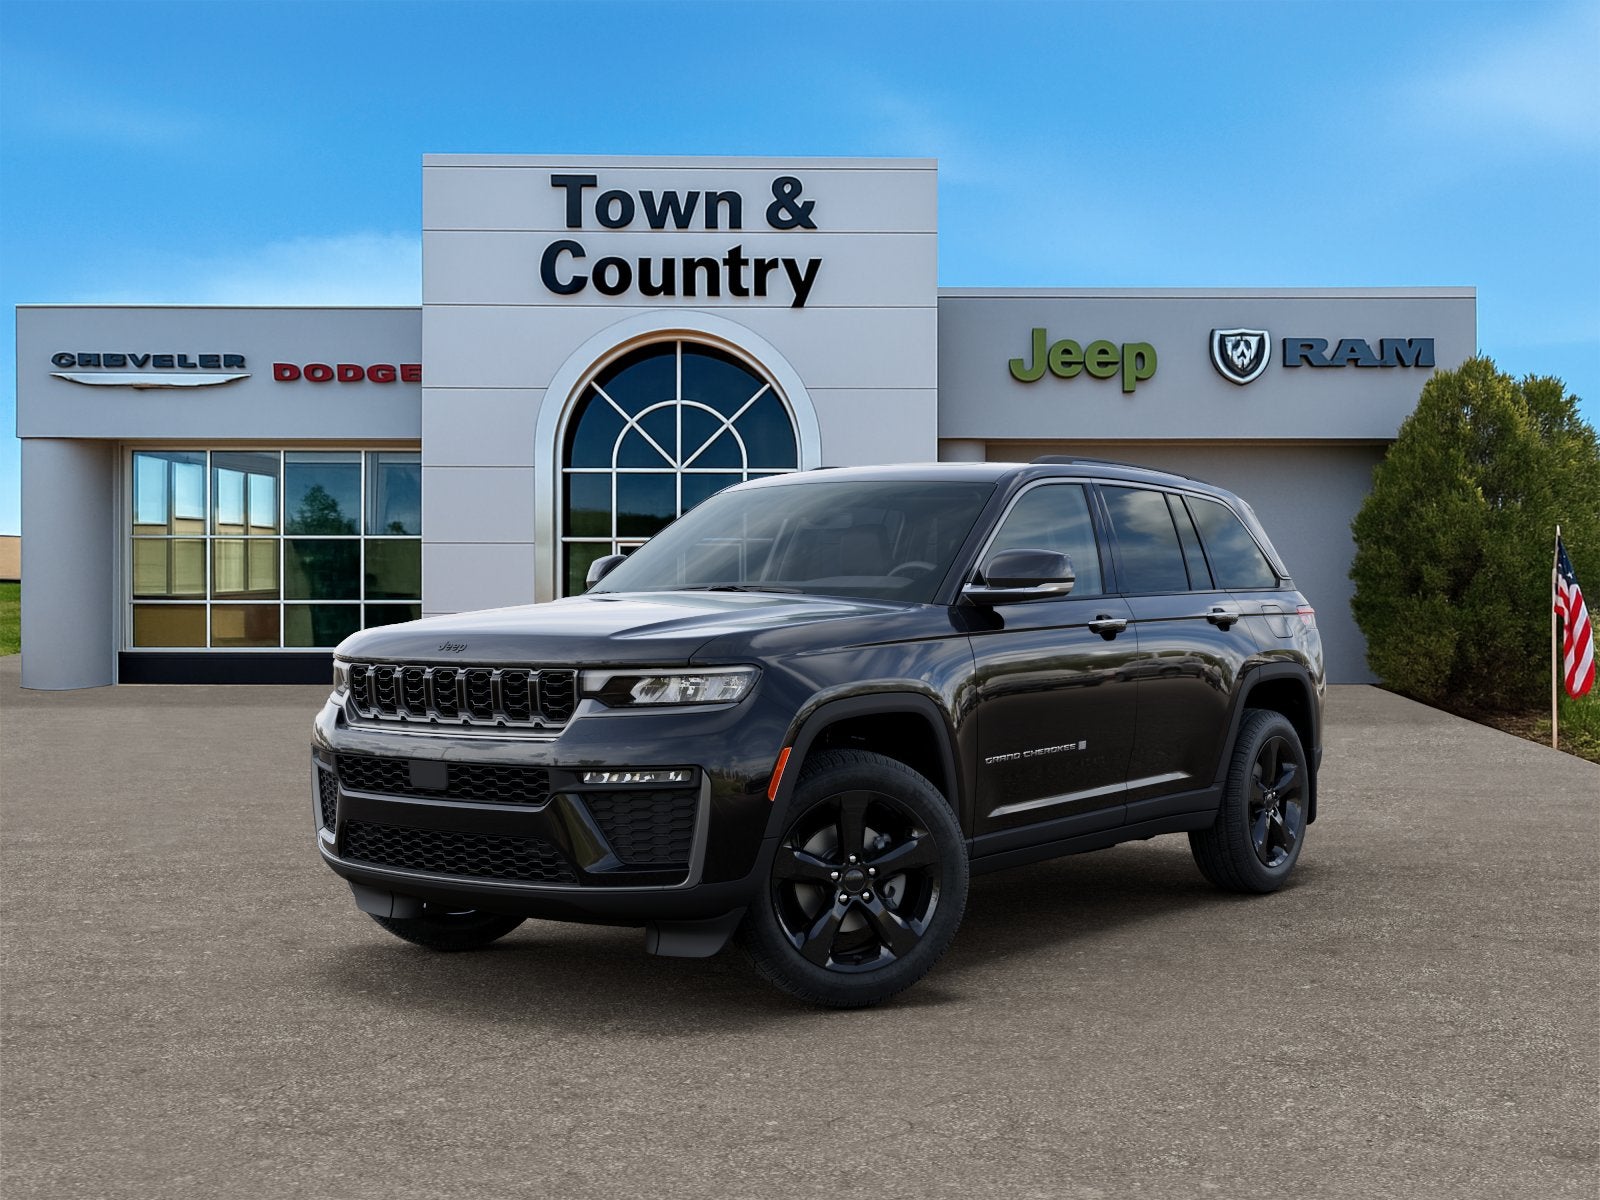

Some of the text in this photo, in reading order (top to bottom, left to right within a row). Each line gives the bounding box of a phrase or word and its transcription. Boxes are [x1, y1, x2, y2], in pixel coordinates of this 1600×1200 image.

[550, 174, 818, 230] Town &
[539, 239, 823, 308] Country
[1009, 328, 1157, 393] Jeep
[1283, 338, 1435, 367] RAM
[273, 363, 421, 383] DODGE
[438, 641, 467, 654] Jeep
[985, 743, 1076, 764] GRAND CHEROKEE
